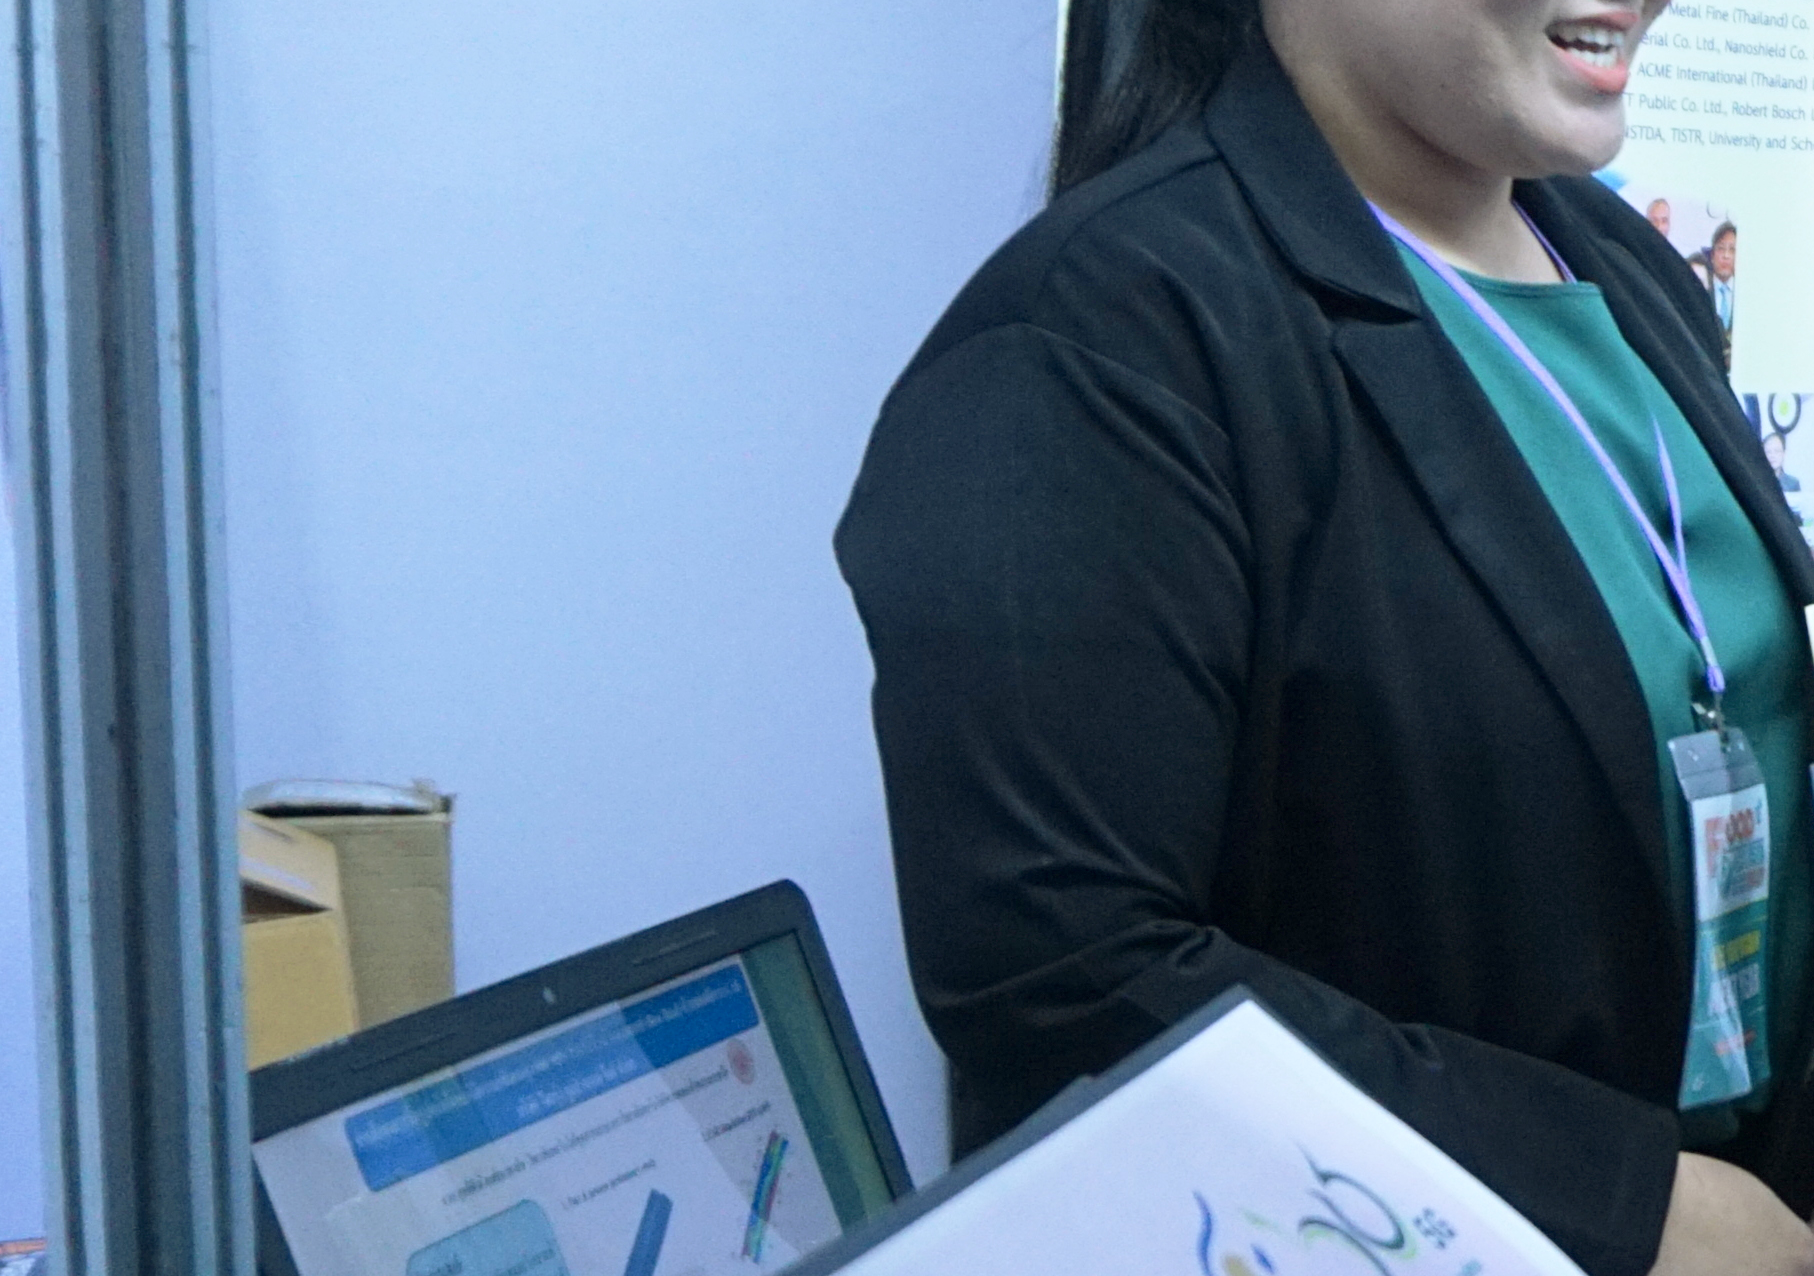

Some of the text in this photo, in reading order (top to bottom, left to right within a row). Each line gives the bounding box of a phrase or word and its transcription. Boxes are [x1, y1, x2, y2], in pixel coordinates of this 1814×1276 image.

[1668, 1, 1701, 19] Metal
[1706, 5, 1728, 22] Fine
[1733, 7, 1789, 29] (Thailand)
[1792, 15, 1810, 30] Co.
[1673, 33, 1692, 49] Co.
[1696, 37, 1721, 55] Ltd.,
[1725, 40, 1786, 58] Nanoshield
[1790, 46, 1808, 61] Co.
[1637, 62, 1672, 79] ACME
[1677, 64, 1747, 86] International
[1751, 71, 1808, 92] (Thailand)
[1639, 93, 1677, 110] Public
[1681, 96, 1700, 113] Co.
[1704, 99, 1728, 116] Ltd.,
[1732, 101, 1768, 118] Robert
[1772, 104, 1806, 121] Bosch
[1671, 126, 1705, 145] TISTR,
[1709, 129, 1762, 150] University
[1766, 134, 1786, 149] and
